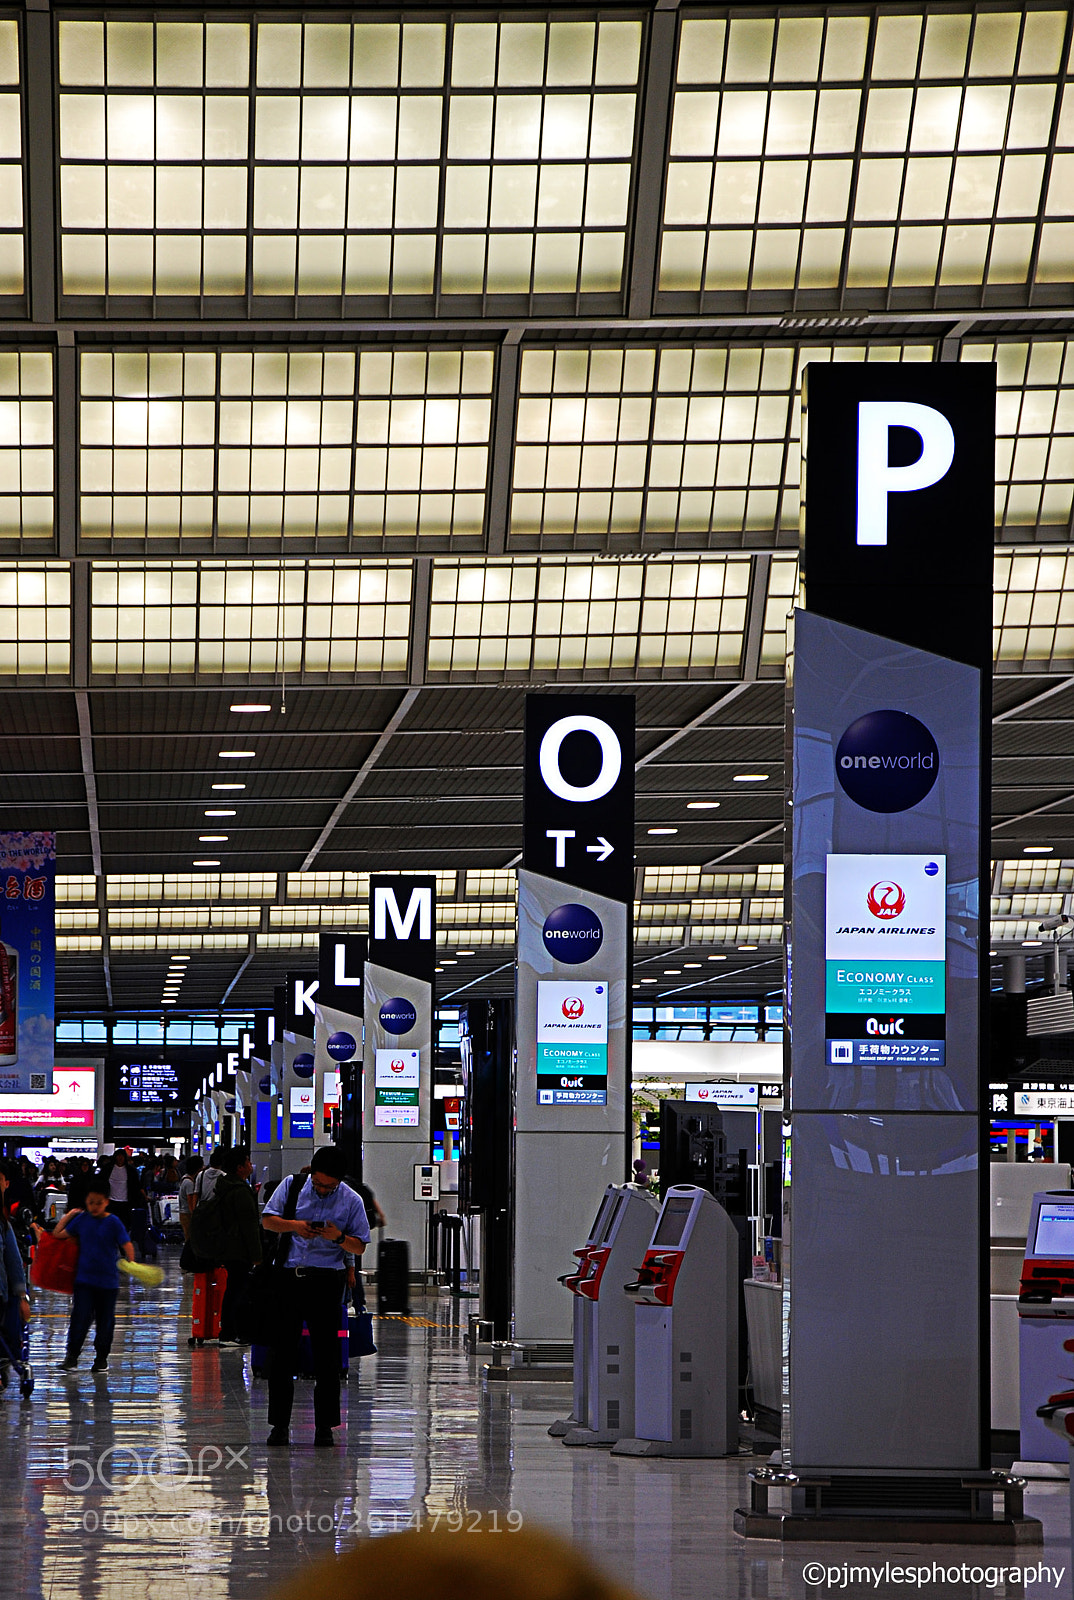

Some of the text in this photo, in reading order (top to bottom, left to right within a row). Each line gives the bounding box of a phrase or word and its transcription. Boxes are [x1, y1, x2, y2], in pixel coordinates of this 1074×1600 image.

[857, 401, 955, 546] P
[539, 715, 622, 802] O
[840, 752, 934, 769] oneworld
[8, 849, 23, 857] THE
[23, 846, 50, 856] WORLD
[546, 830, 576, 868] T
[0, 875, 47, 901] 台酒
[374, 887, 432, 940] M
[876, 908, 899, 916] JAL
[544, 928, 601, 939] oneworld
[835, 927, 936, 936] JAPAN AIRLINES
[30, 926, 42, 991] 中国の国酒
[334, 943, 361, 987] L
[837, 969, 934, 984] ECONOMY CLASS
[294, 980, 320, 1016] K
[859, 988, 912, 996] エコノミークラス
[380, 1012, 416, 1020] oneworld
[327, 1042, 356, 1050] oneworld
[543, 1048, 583, 1057] ECONOMY
[858, 1044, 940, 1056] 手荷物カウンター
[762, 1086, 779, 1096] M2
[988, 1093, 1009, 1112] 険
